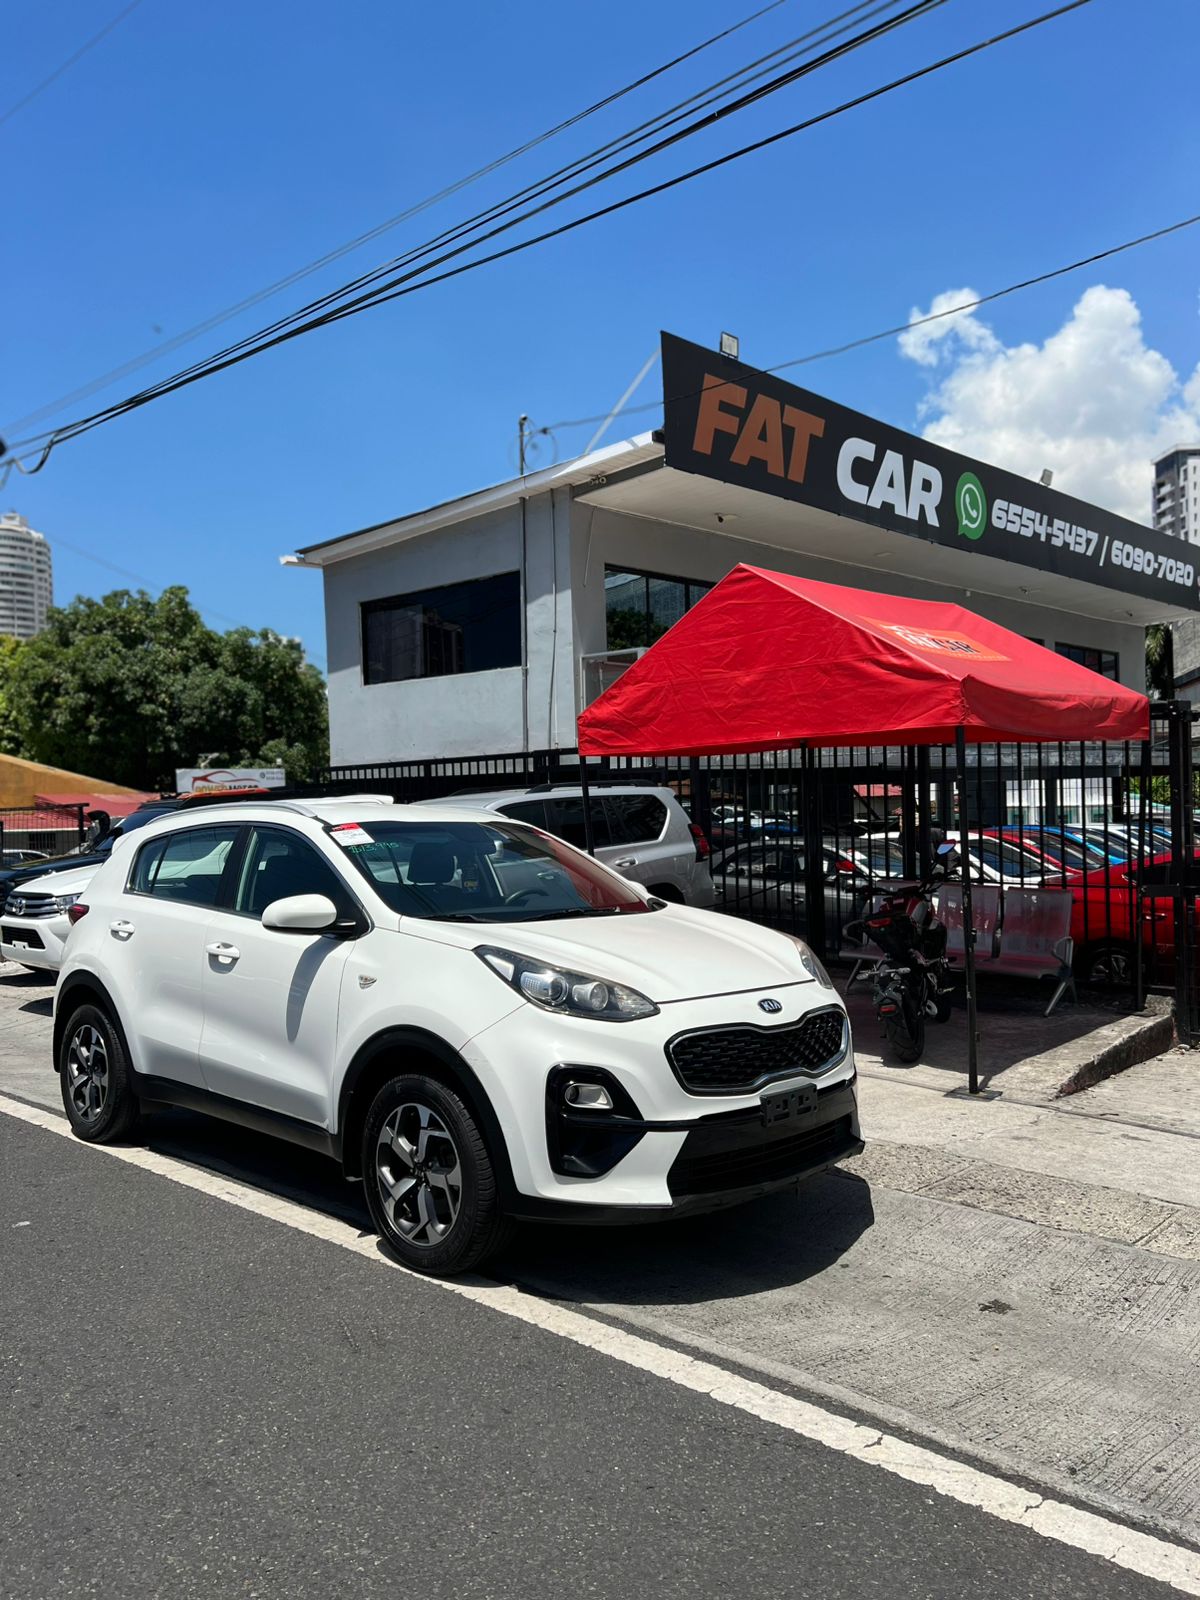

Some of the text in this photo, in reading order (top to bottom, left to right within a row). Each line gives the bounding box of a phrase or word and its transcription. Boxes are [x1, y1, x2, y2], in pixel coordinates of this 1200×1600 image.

[692, 373, 943, 527] FAT CAR
[991, 498, 1099, 556] 6554-5437
[1111, 540, 1194, 588] 6090-7020
[760, 999, 782, 1011] KIA
